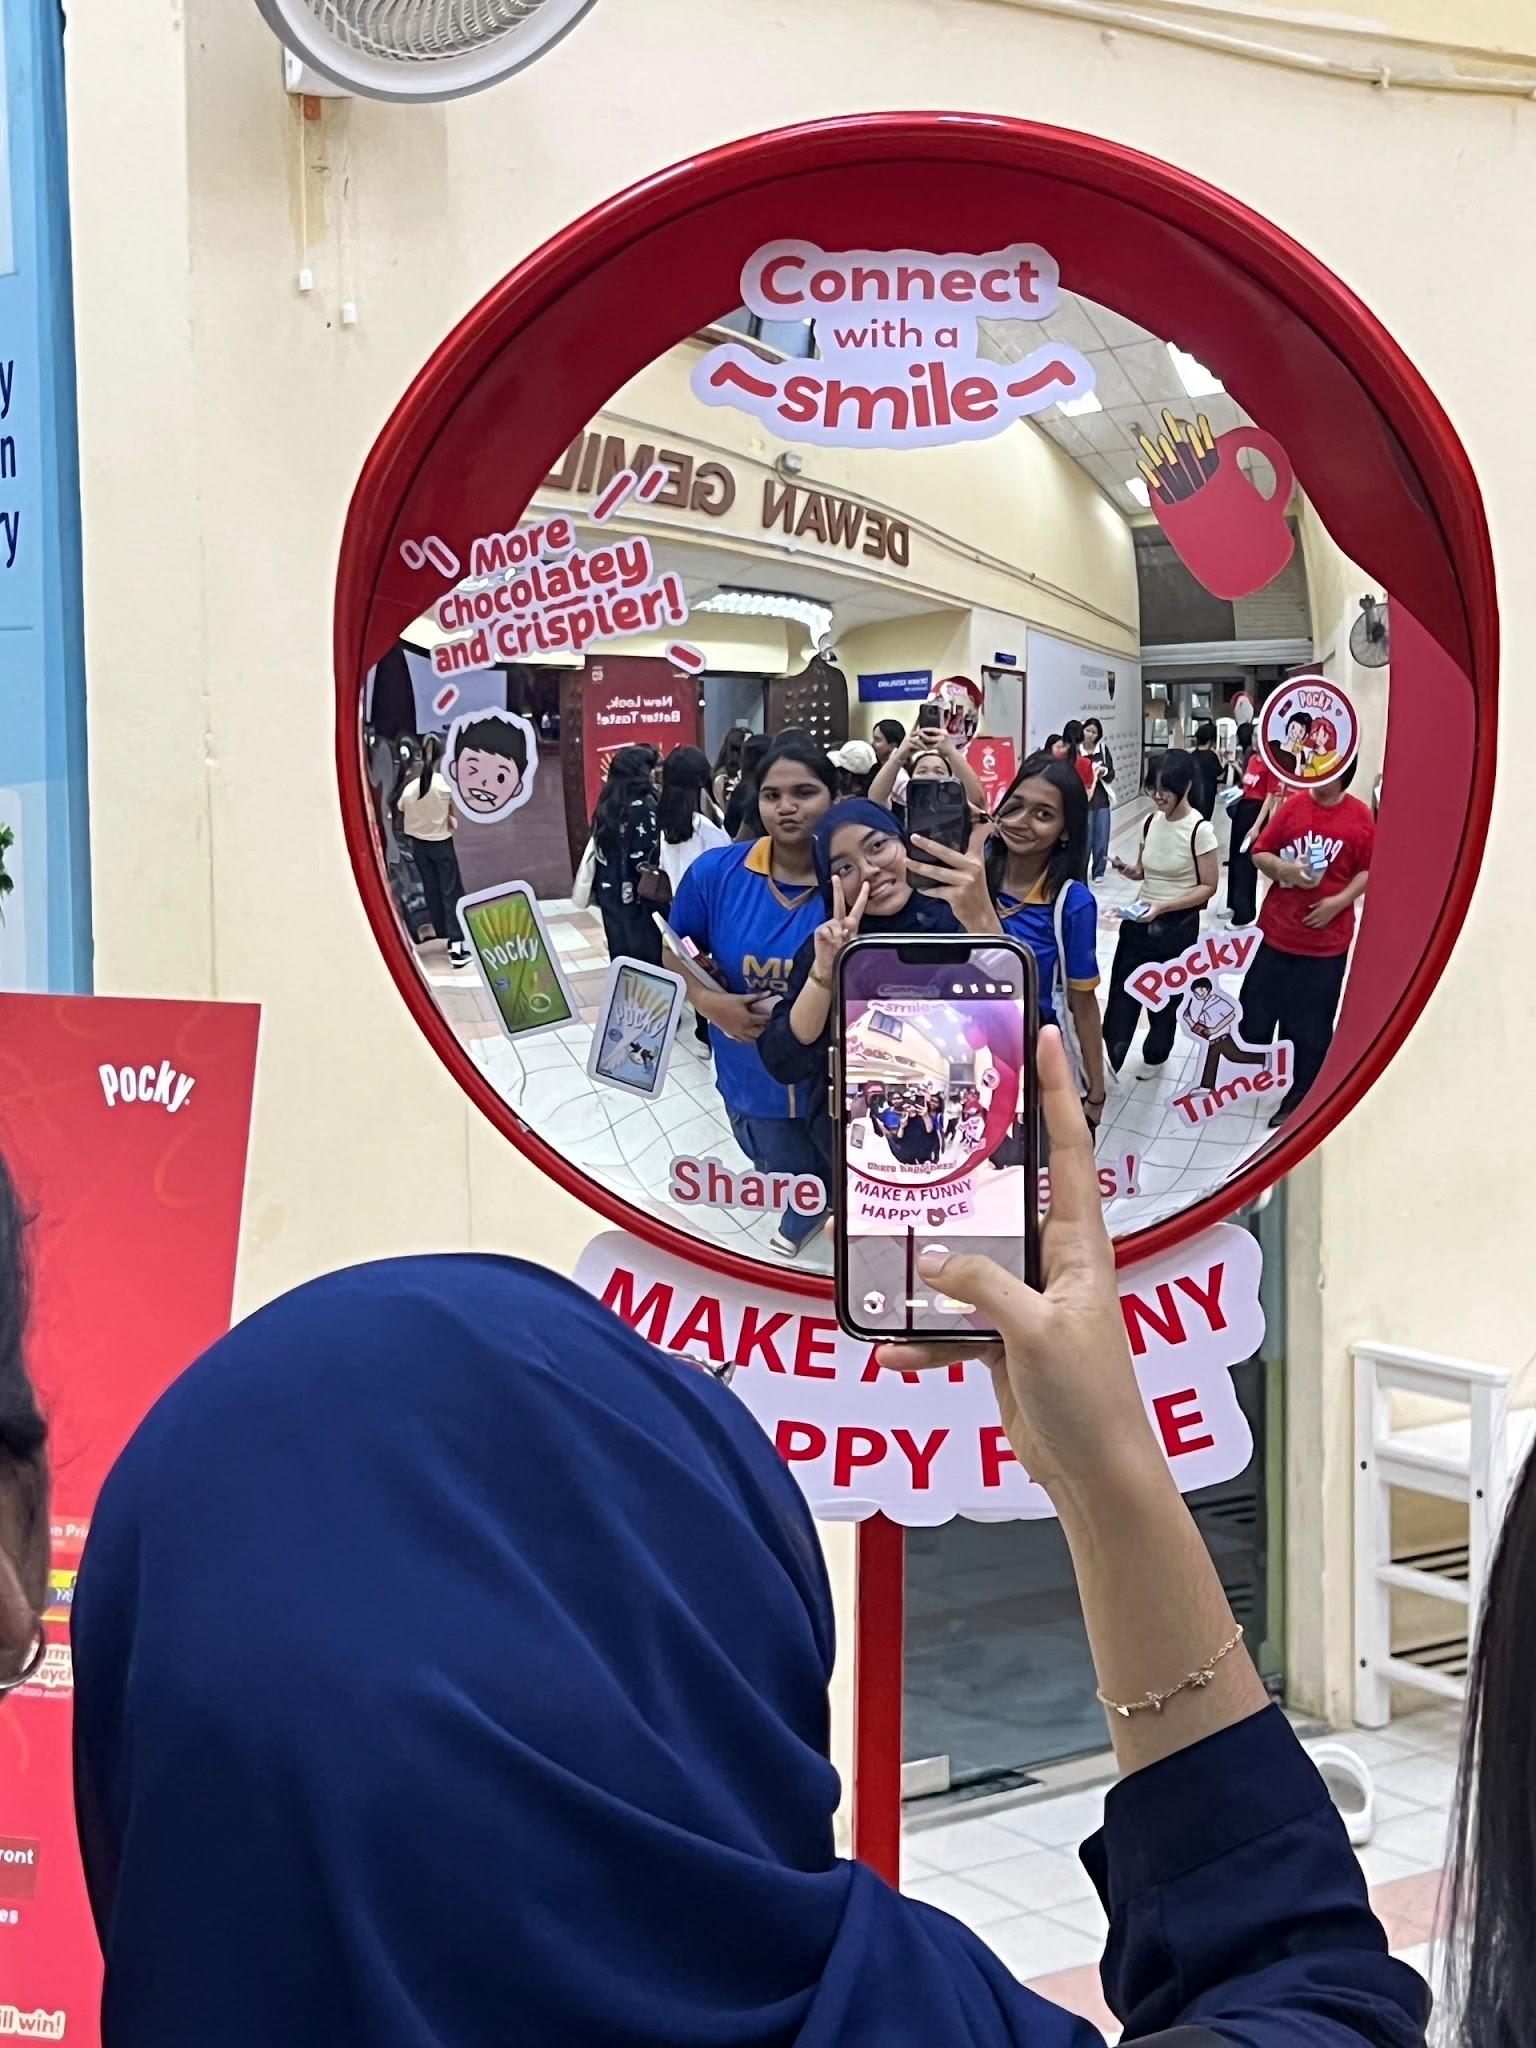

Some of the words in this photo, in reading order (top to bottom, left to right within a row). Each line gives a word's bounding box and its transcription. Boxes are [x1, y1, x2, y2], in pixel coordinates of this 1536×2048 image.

[759, 255, 1040, 305] Connect
[833, 318, 923, 349] with
[934, 328, 958, 349] a
[777, 361, 999, 430] smile
[475, 519, 571, 577] More
[435, 629, 490, 673] and
[1132, 935, 1256, 1006] Pocky
[1172, 1048, 1288, 1123] Time!
[674, 1160, 820, 1211] Share
[854, 1181, 902, 1201] MAKE
[905, 1190, 917, 1201] A
[920, 1179, 973, 1201] FUNNY
[600, 1267, 839, 1379] MAKE
[19, 2013, 61, 2034] win!
